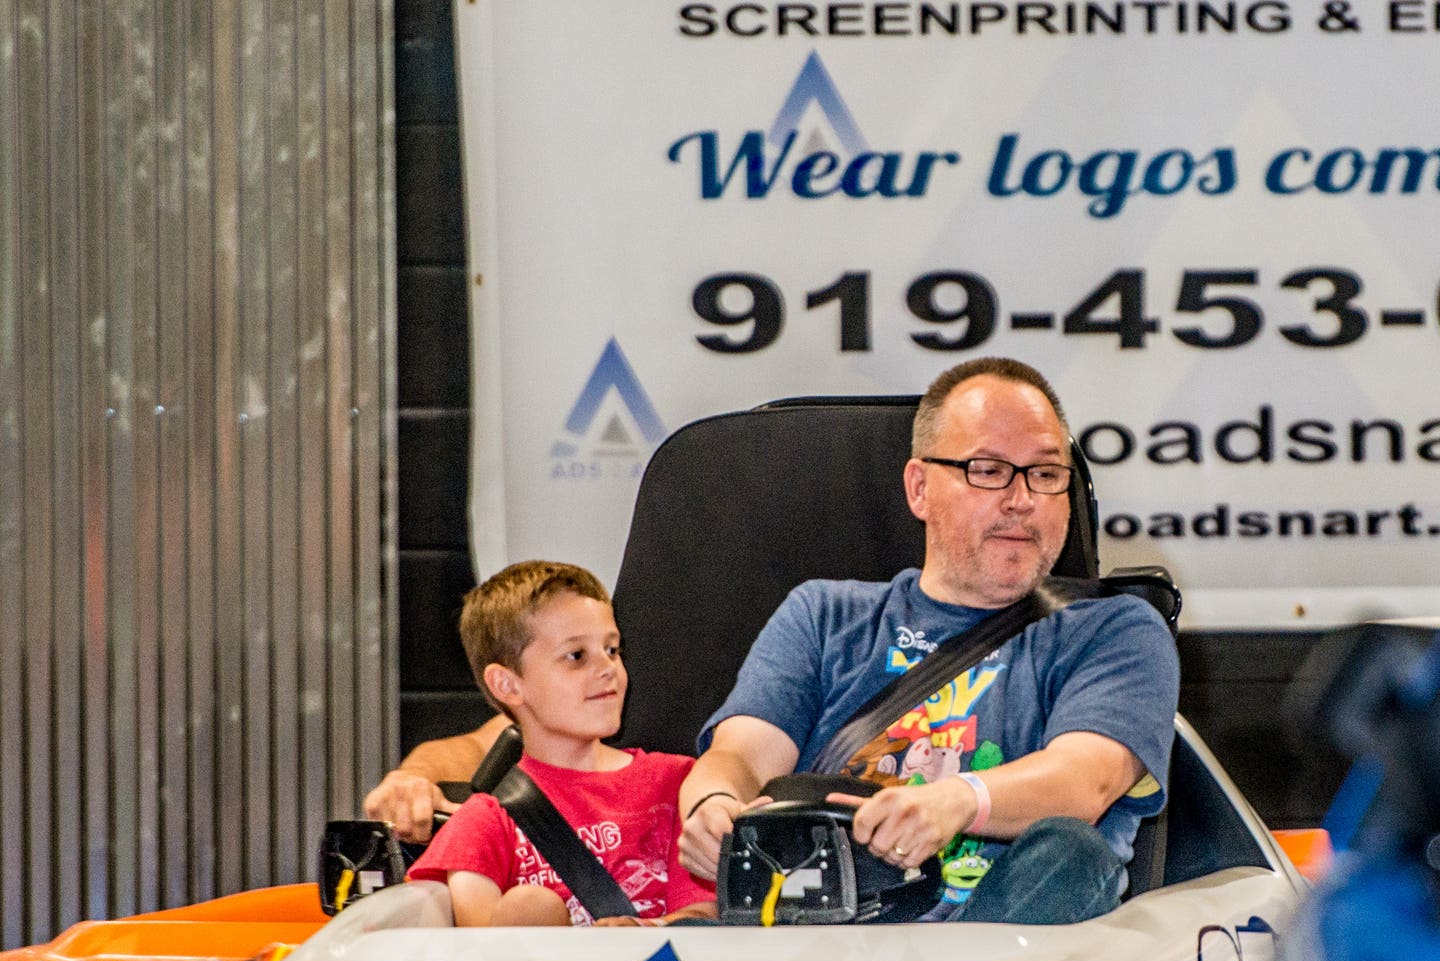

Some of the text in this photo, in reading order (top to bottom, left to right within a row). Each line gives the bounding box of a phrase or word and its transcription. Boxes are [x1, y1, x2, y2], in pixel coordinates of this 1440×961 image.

[679, 1, 1292, 38] SCREENPRINTING
[1318, 1, 1362, 34] &
[667, 130, 960, 200] Wear
[985, 133, 1236, 219] logos
